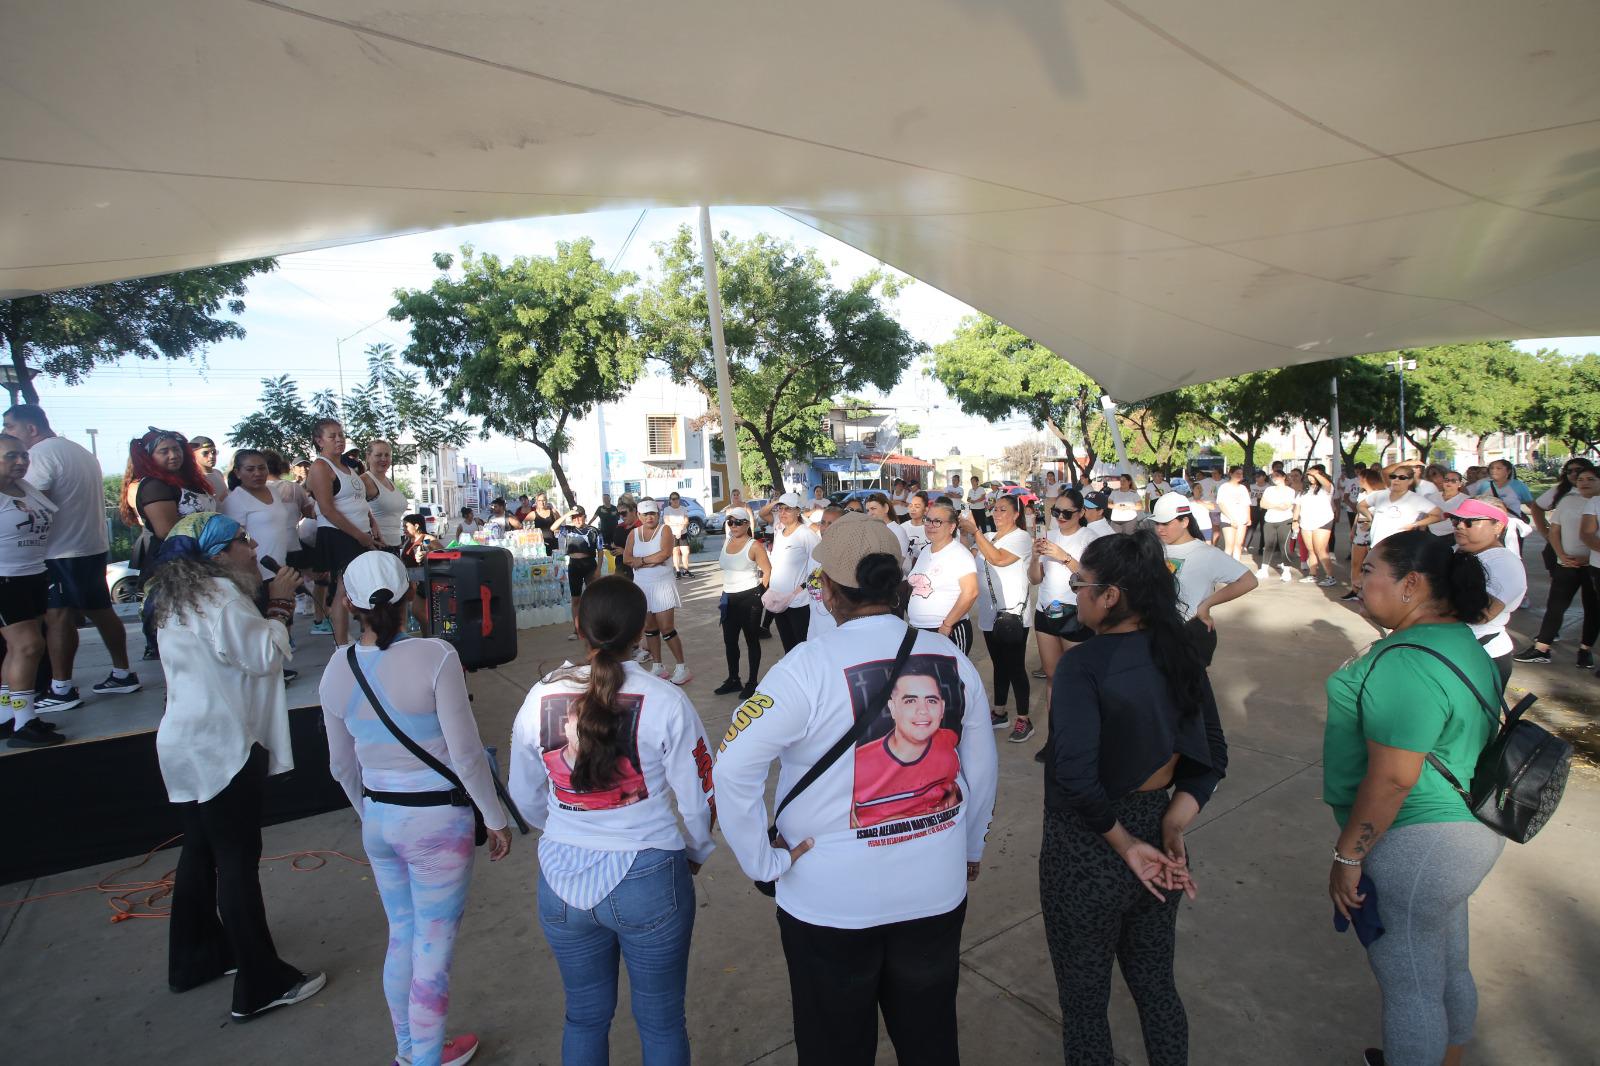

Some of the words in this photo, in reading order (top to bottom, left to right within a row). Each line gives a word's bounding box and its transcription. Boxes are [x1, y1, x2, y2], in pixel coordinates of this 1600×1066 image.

[857, 827, 878, 839] ISMAEL
[879, 821, 912, 837] ALEJANDRO
[911, 816, 938, 830] MARTINEZ
